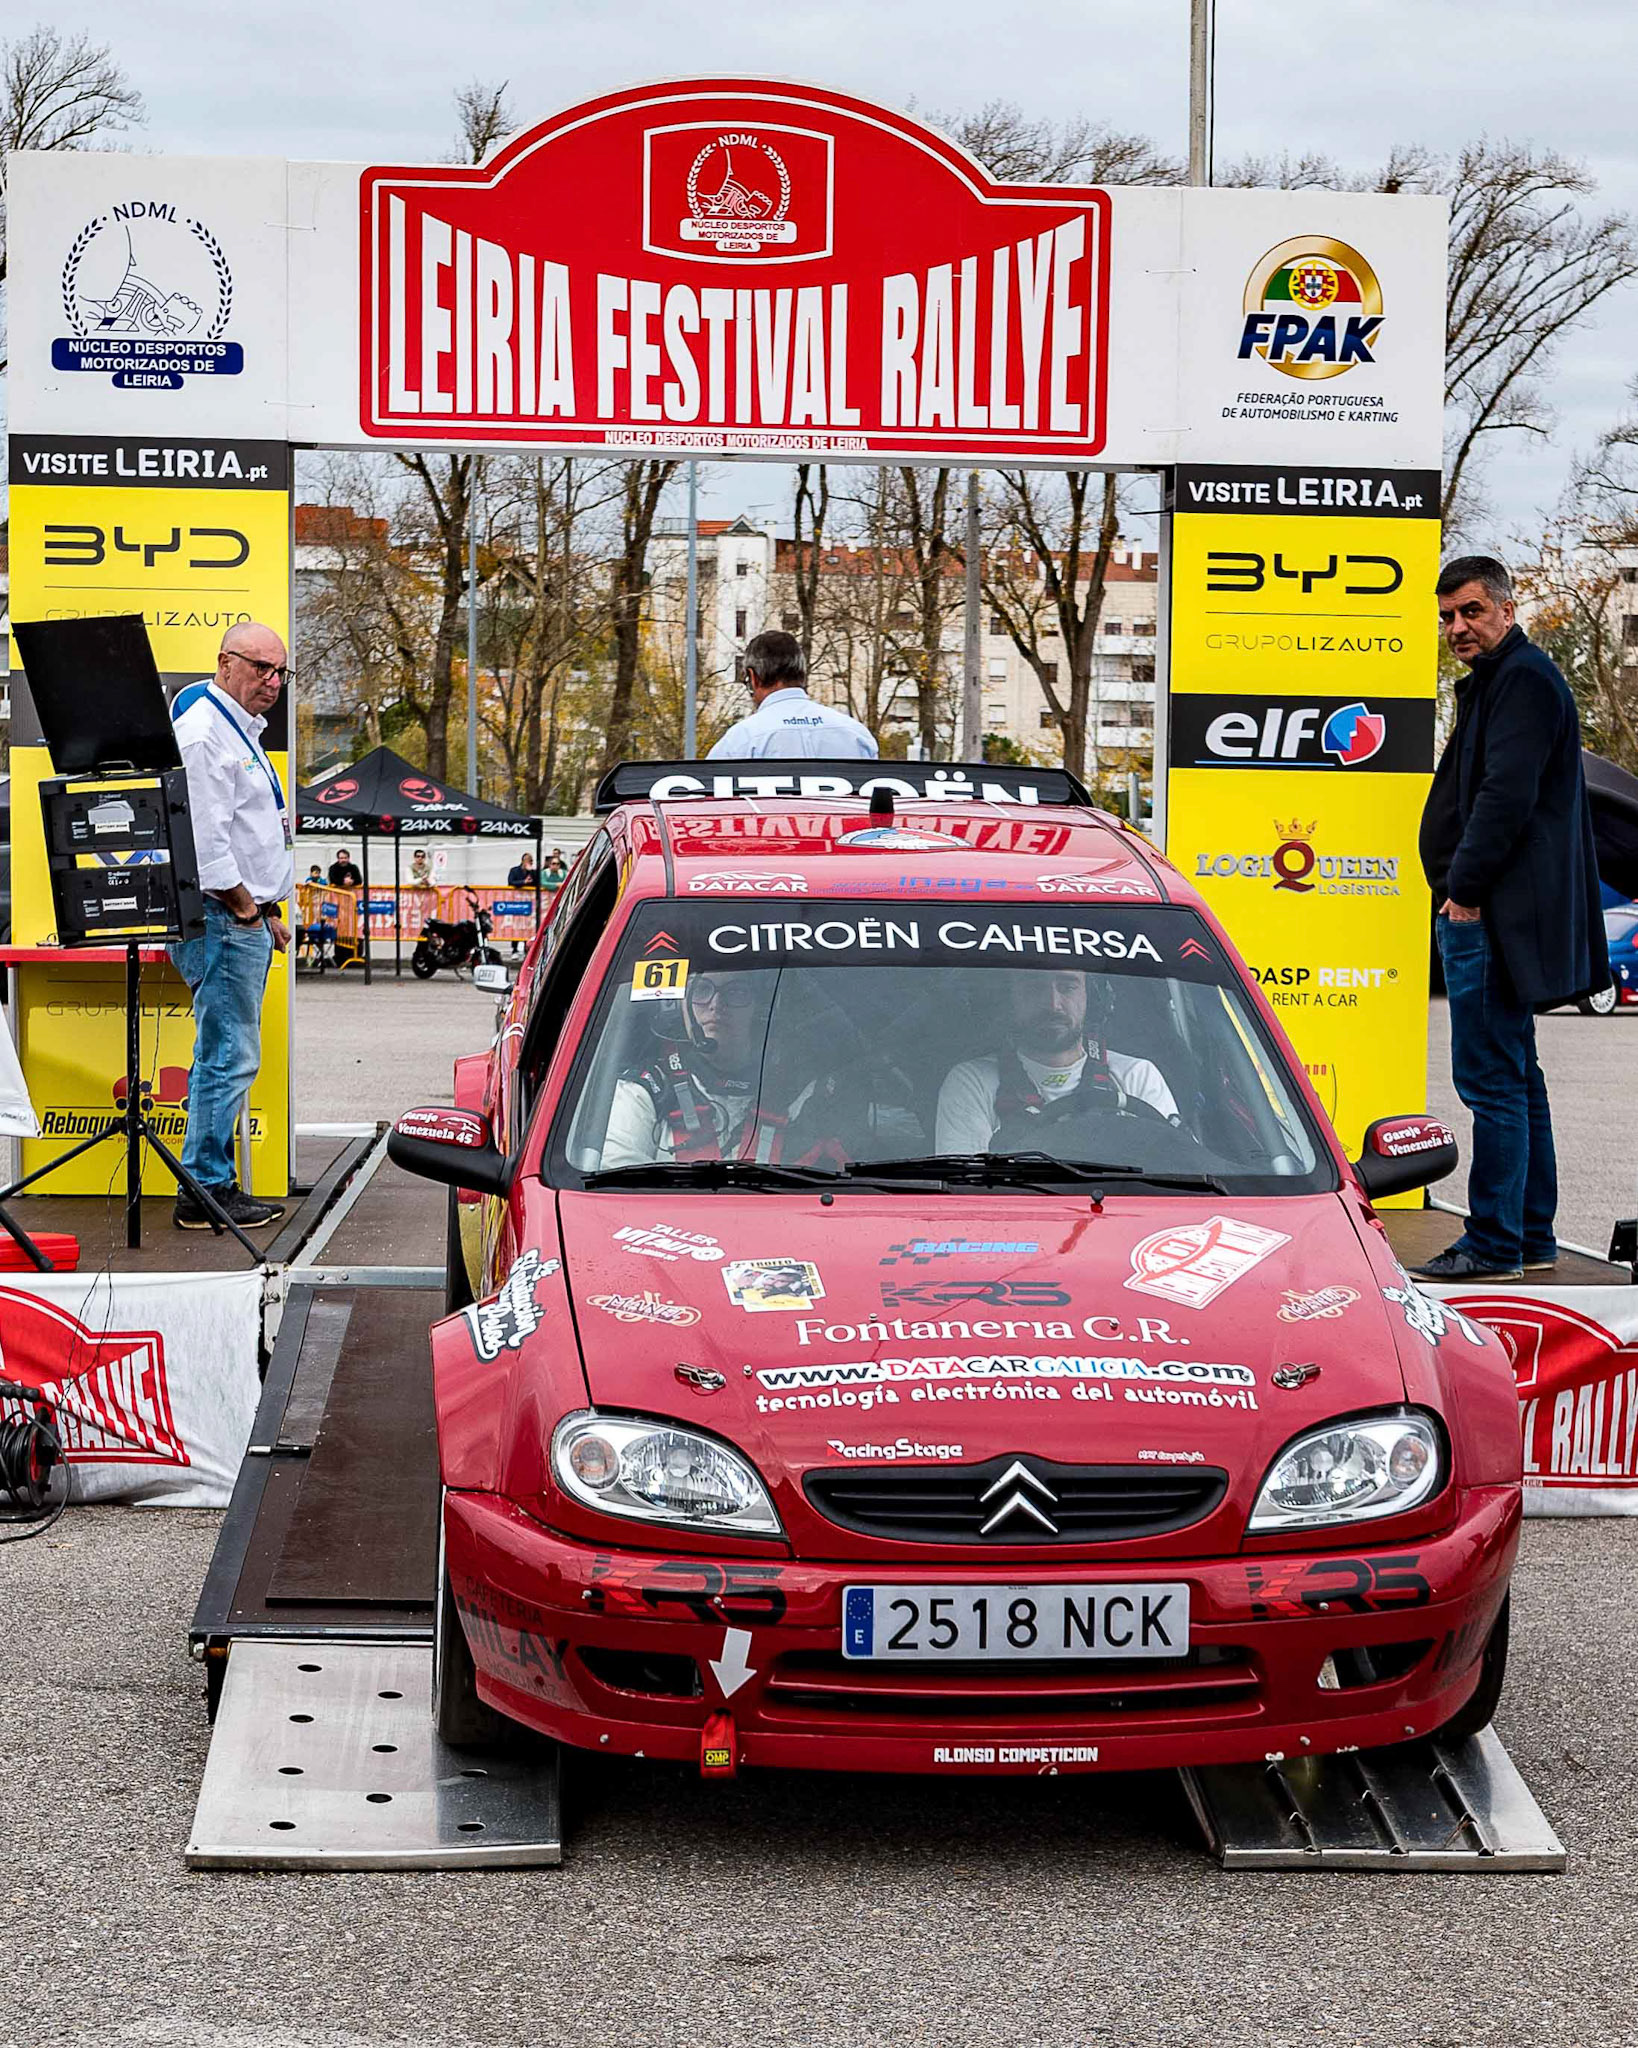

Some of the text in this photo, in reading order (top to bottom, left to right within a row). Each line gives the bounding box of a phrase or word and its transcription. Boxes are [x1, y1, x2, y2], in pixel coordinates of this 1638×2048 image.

[717, 133, 759, 149] NDML
[112, 201, 180, 225] NDML
[698, 231, 779, 241] MOTORIZADOS DE
[730, 221, 786, 232] DESPORTOS
[723, 241, 753, 250] LEIRIA
[387, 193, 1087, 433] LEIRIA FESTIVAL RALLYE
[68, 338, 227, 357] NÚCLEO DESPORTOS
[1237, 312, 1387, 364] FPAK
[80, 356, 216, 373] MOTORIZADOS DE
[123, 373, 172, 387] LEIRIA
[1236, 391, 1384, 408] FEDERAÇÃO PORTUGUESA
[1221, 408, 1399, 423] DE AUTOMOBILISMO E KARTING
[655, 431, 725, 448] DESPORTOS
[726, 434, 811, 449] MOTORIZADOS
[812, 436, 828, 450] DE
[829, 436, 869, 451] LEIRIA
[23, 452, 108, 476] VISITE
[1188, 481, 1271, 504] VISITE
[44, 523, 250, 568] BYD
[1206, 552, 1404, 594] BYD
[782, 715, 824, 727] ndml.pt
[1204, 708, 1321, 758] elf
[1195, 841, 1400, 893] LOGIQUEEN
[688, 879, 809, 893] DATACAR
[1038, 880, 1156, 897] DATACAR
[708, 917, 1164, 963] CITROËN CAHERSA
[644, 962, 680, 988] 61
[1272, 993, 1358, 1007] RENT A CAR
[398, 1122, 473, 1144] Venezuela 45
[1383, 1127, 1421, 1143] Garaje
[1388, 1134, 1455, 1157] Venezuela 45
[651, 1223, 718, 1246] TALLER
[912, 1241, 1040, 1254] RACING
[1082, 1315, 1192, 1346] C.R.
[756, 1380, 1259, 1413] tecnología electrónica del automóvil
[827, 1438, 963, 1460] RacingStage
[887, 1594, 1174, 1651] 2518 NCK
[854, 1630, 864, 1644] E
[705, 1752, 729, 1763] OMP
[934, 1747, 1099, 1763] ALONSO COMPETICION
